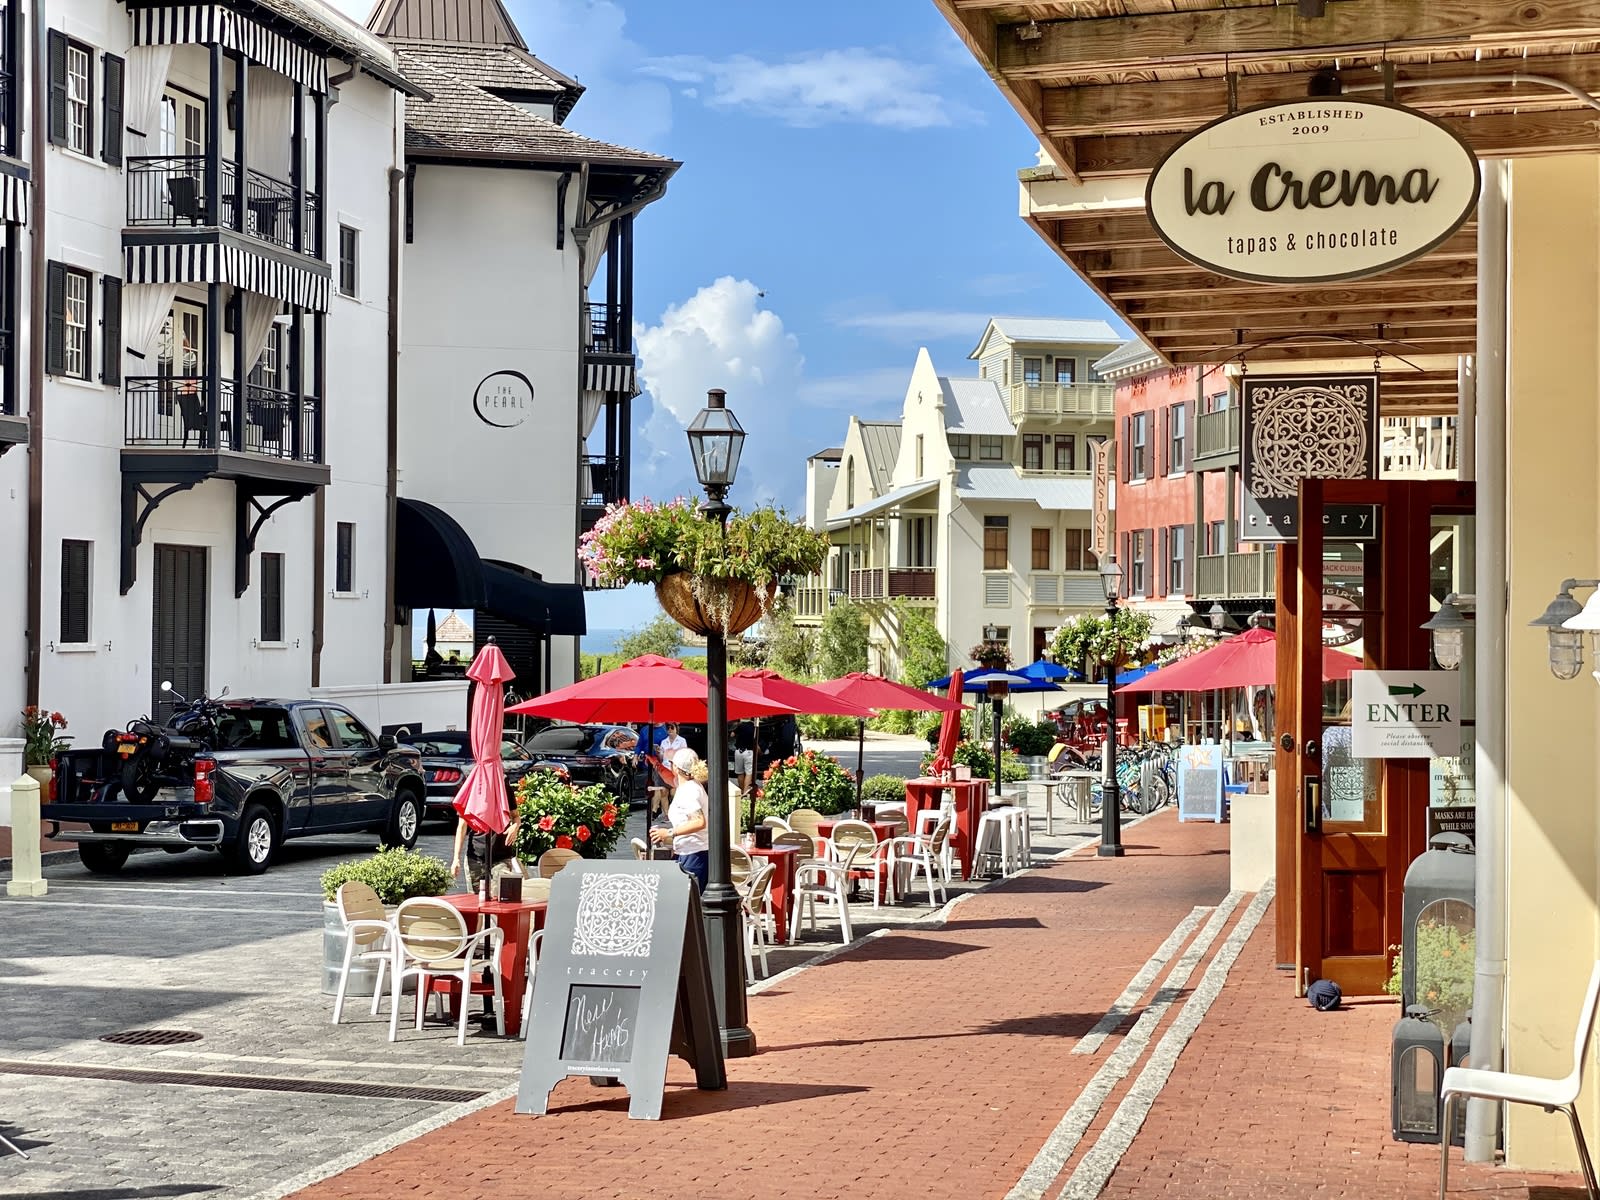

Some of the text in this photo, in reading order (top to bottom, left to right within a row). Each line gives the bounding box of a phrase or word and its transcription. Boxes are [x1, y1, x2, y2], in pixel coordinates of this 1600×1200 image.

[1258, 109, 1365, 126] ESTABLISHED
[1291, 124, 1330, 136] 2009
[1183, 161, 1440, 217] la Crema
[1227, 227, 1399, 255] tapas & chocolate
[497, 386, 512, 395] THE
[1095, 451, 1107, 549] PENSIONE
[1248, 513, 1369, 529] traery
[1339, 564, 1362, 572] CUISIN
[1323, 588, 1356, 601] GIRL
[1322, 632, 1355, 645] CHEN
[1366, 703, 1452, 722] ENTER
[1434, 811, 1454, 820] MASKS
[1454, 811, 1466, 819] ARE
[1440, 822, 1460, 831] WHILE
[566, 966, 649, 981] tracery
[572, 992, 614, 1033] New
